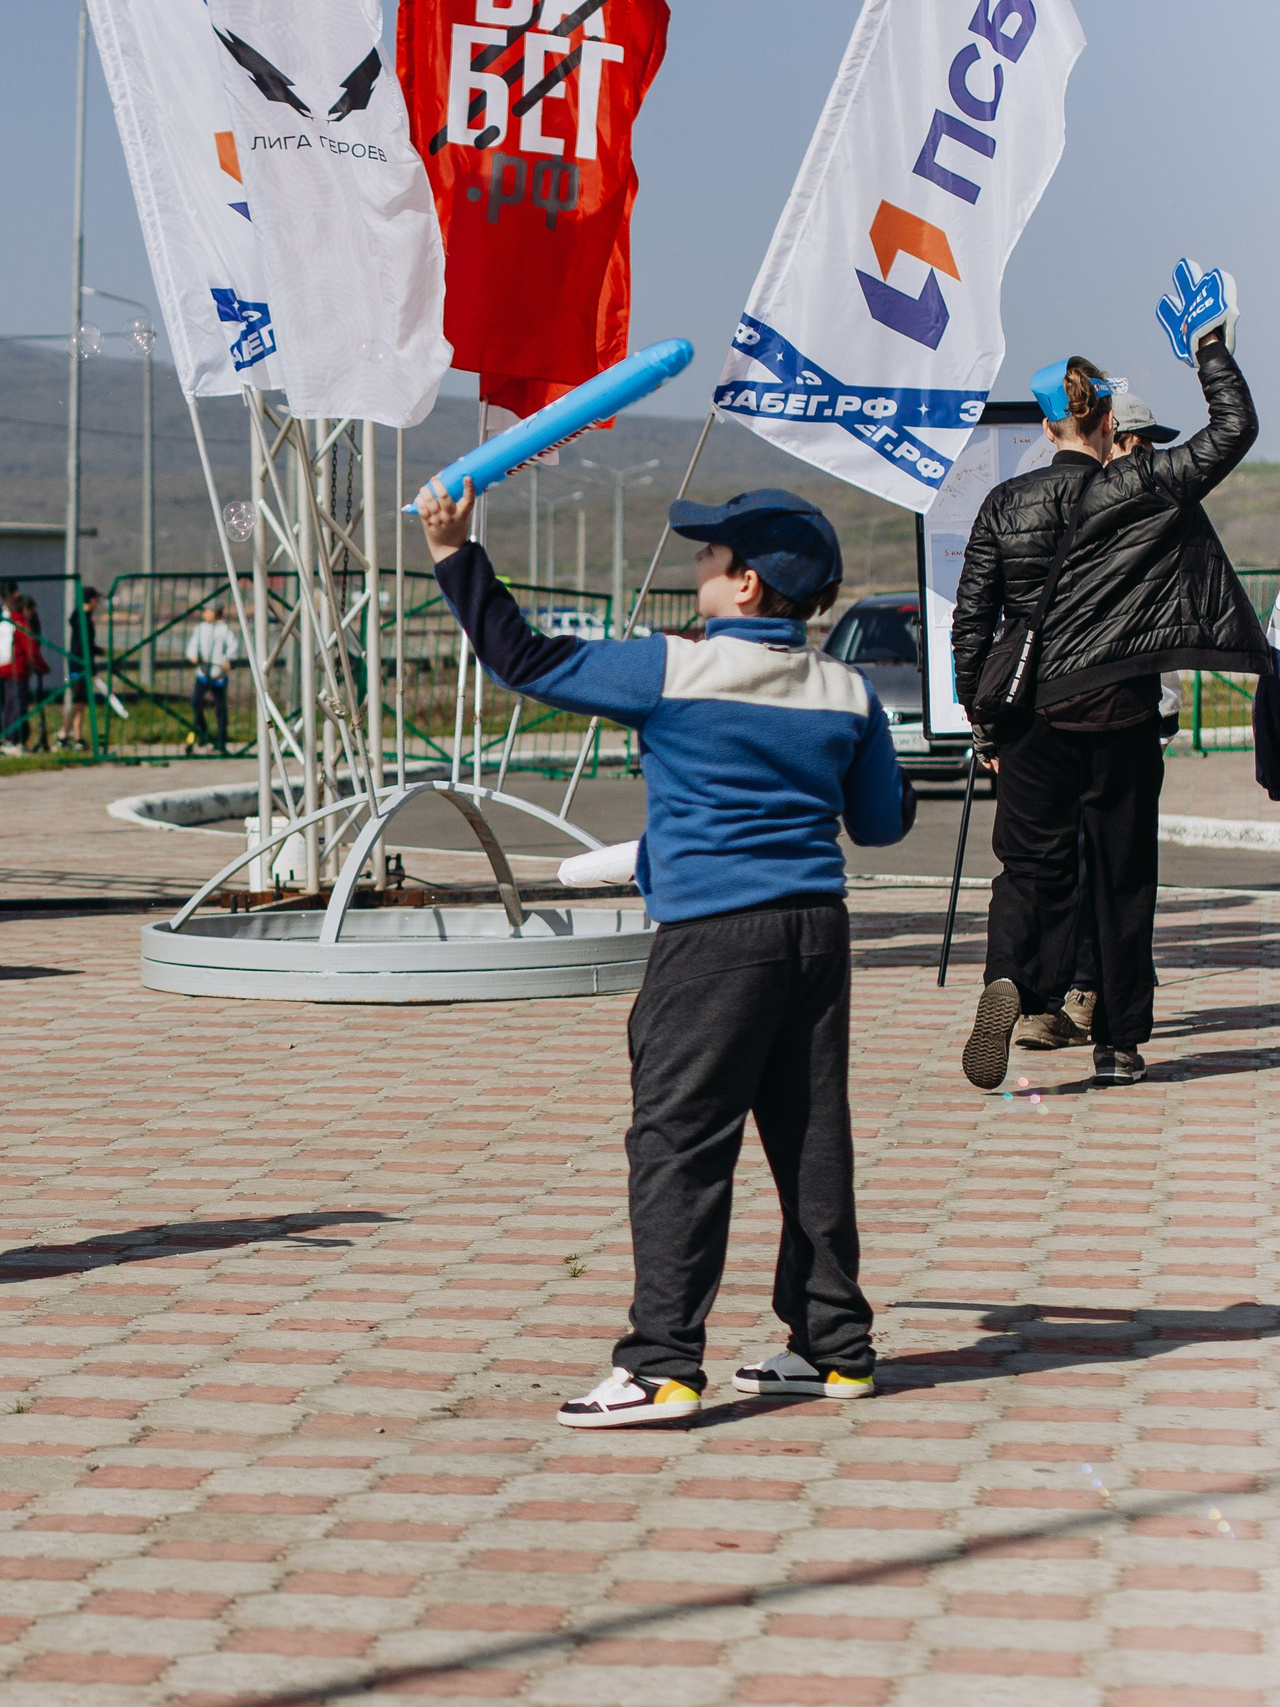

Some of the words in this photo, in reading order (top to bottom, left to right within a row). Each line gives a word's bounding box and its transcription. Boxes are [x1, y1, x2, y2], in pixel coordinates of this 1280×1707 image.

[447, 23, 625, 160] БЕГ
[251, 134, 312, 150] ЛИГА
[319, 135, 387, 163] ГЕРОЕВ
[466, 151, 581, 232] .рф
[718, 389, 898, 419] ЗАБЕГ.РФ
